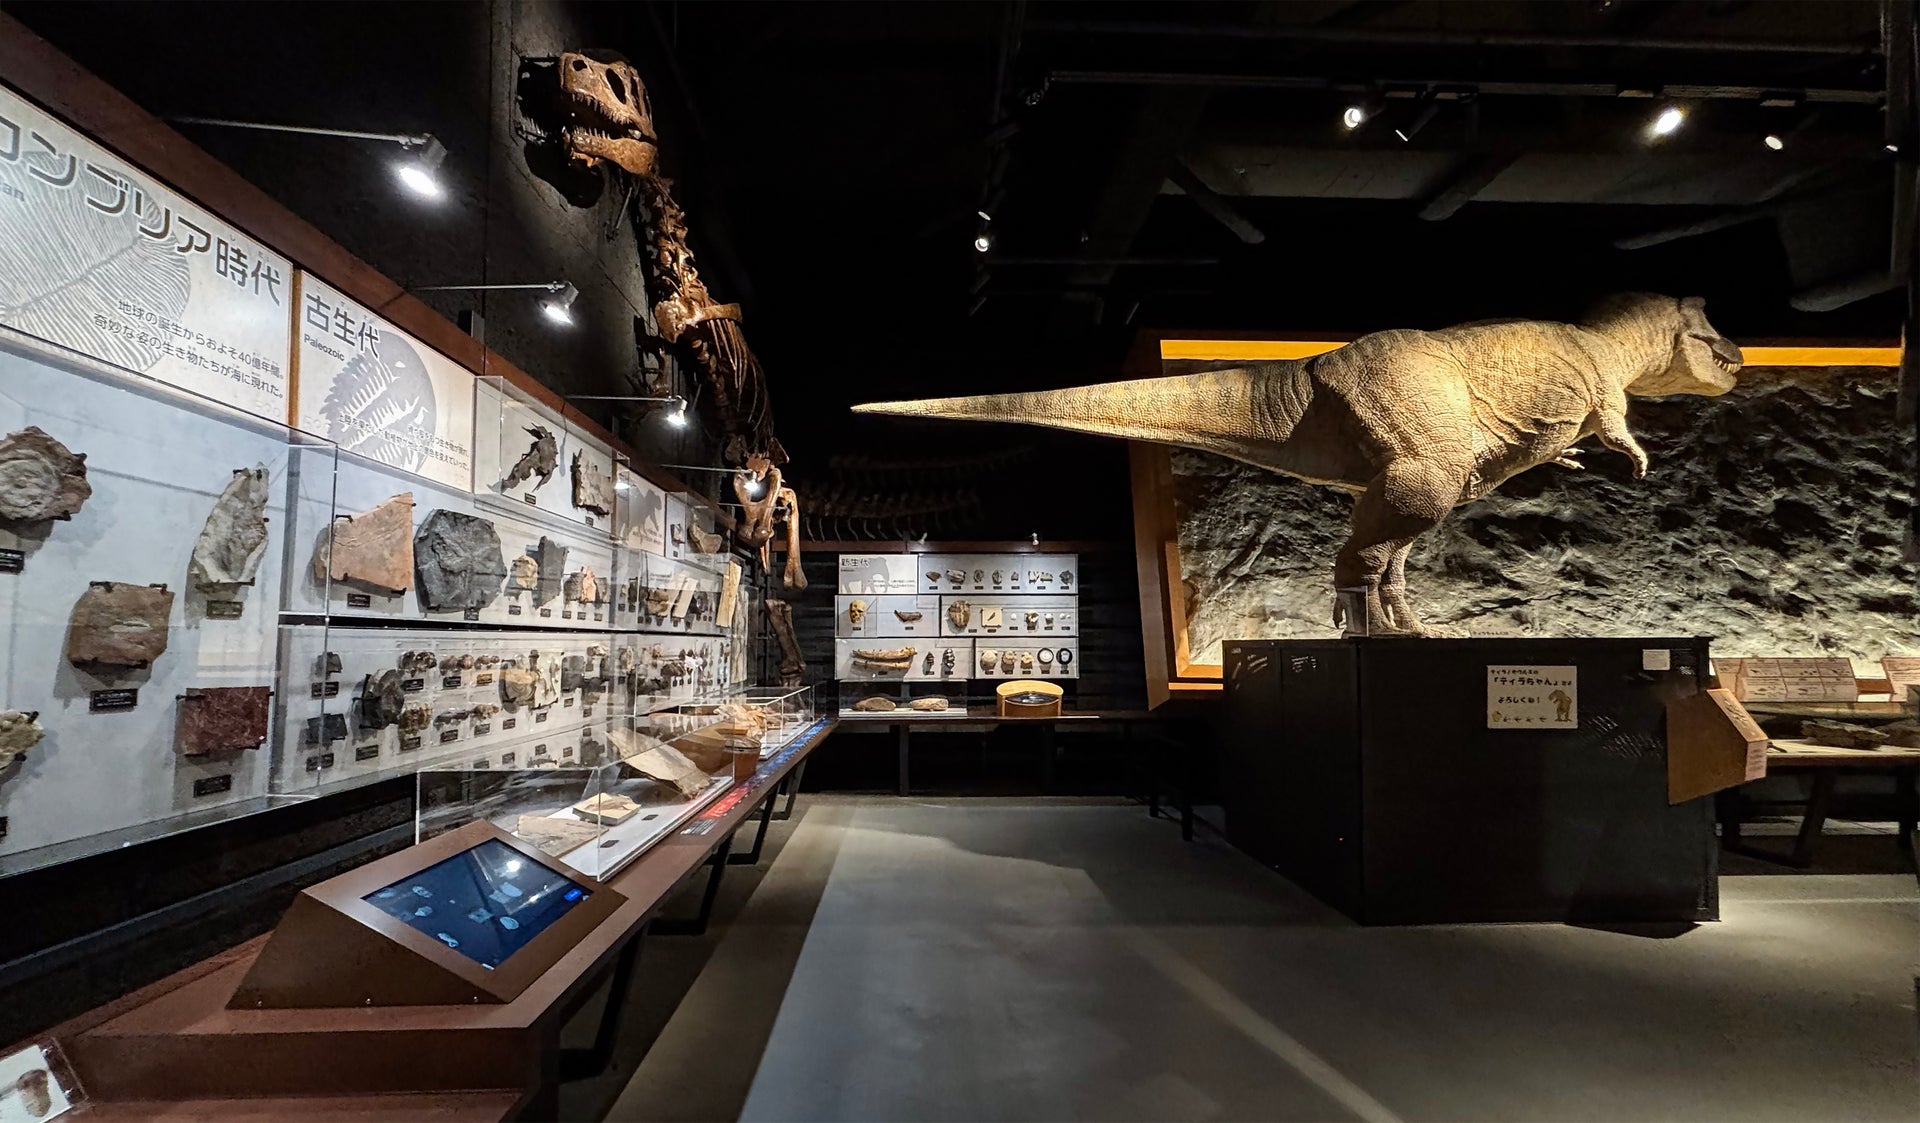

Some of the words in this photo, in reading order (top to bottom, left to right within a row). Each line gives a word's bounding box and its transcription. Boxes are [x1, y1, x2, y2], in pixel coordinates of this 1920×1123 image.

[304, 333, 345, 361] Paleozoic
[306, 293, 379, 358] 古生代
